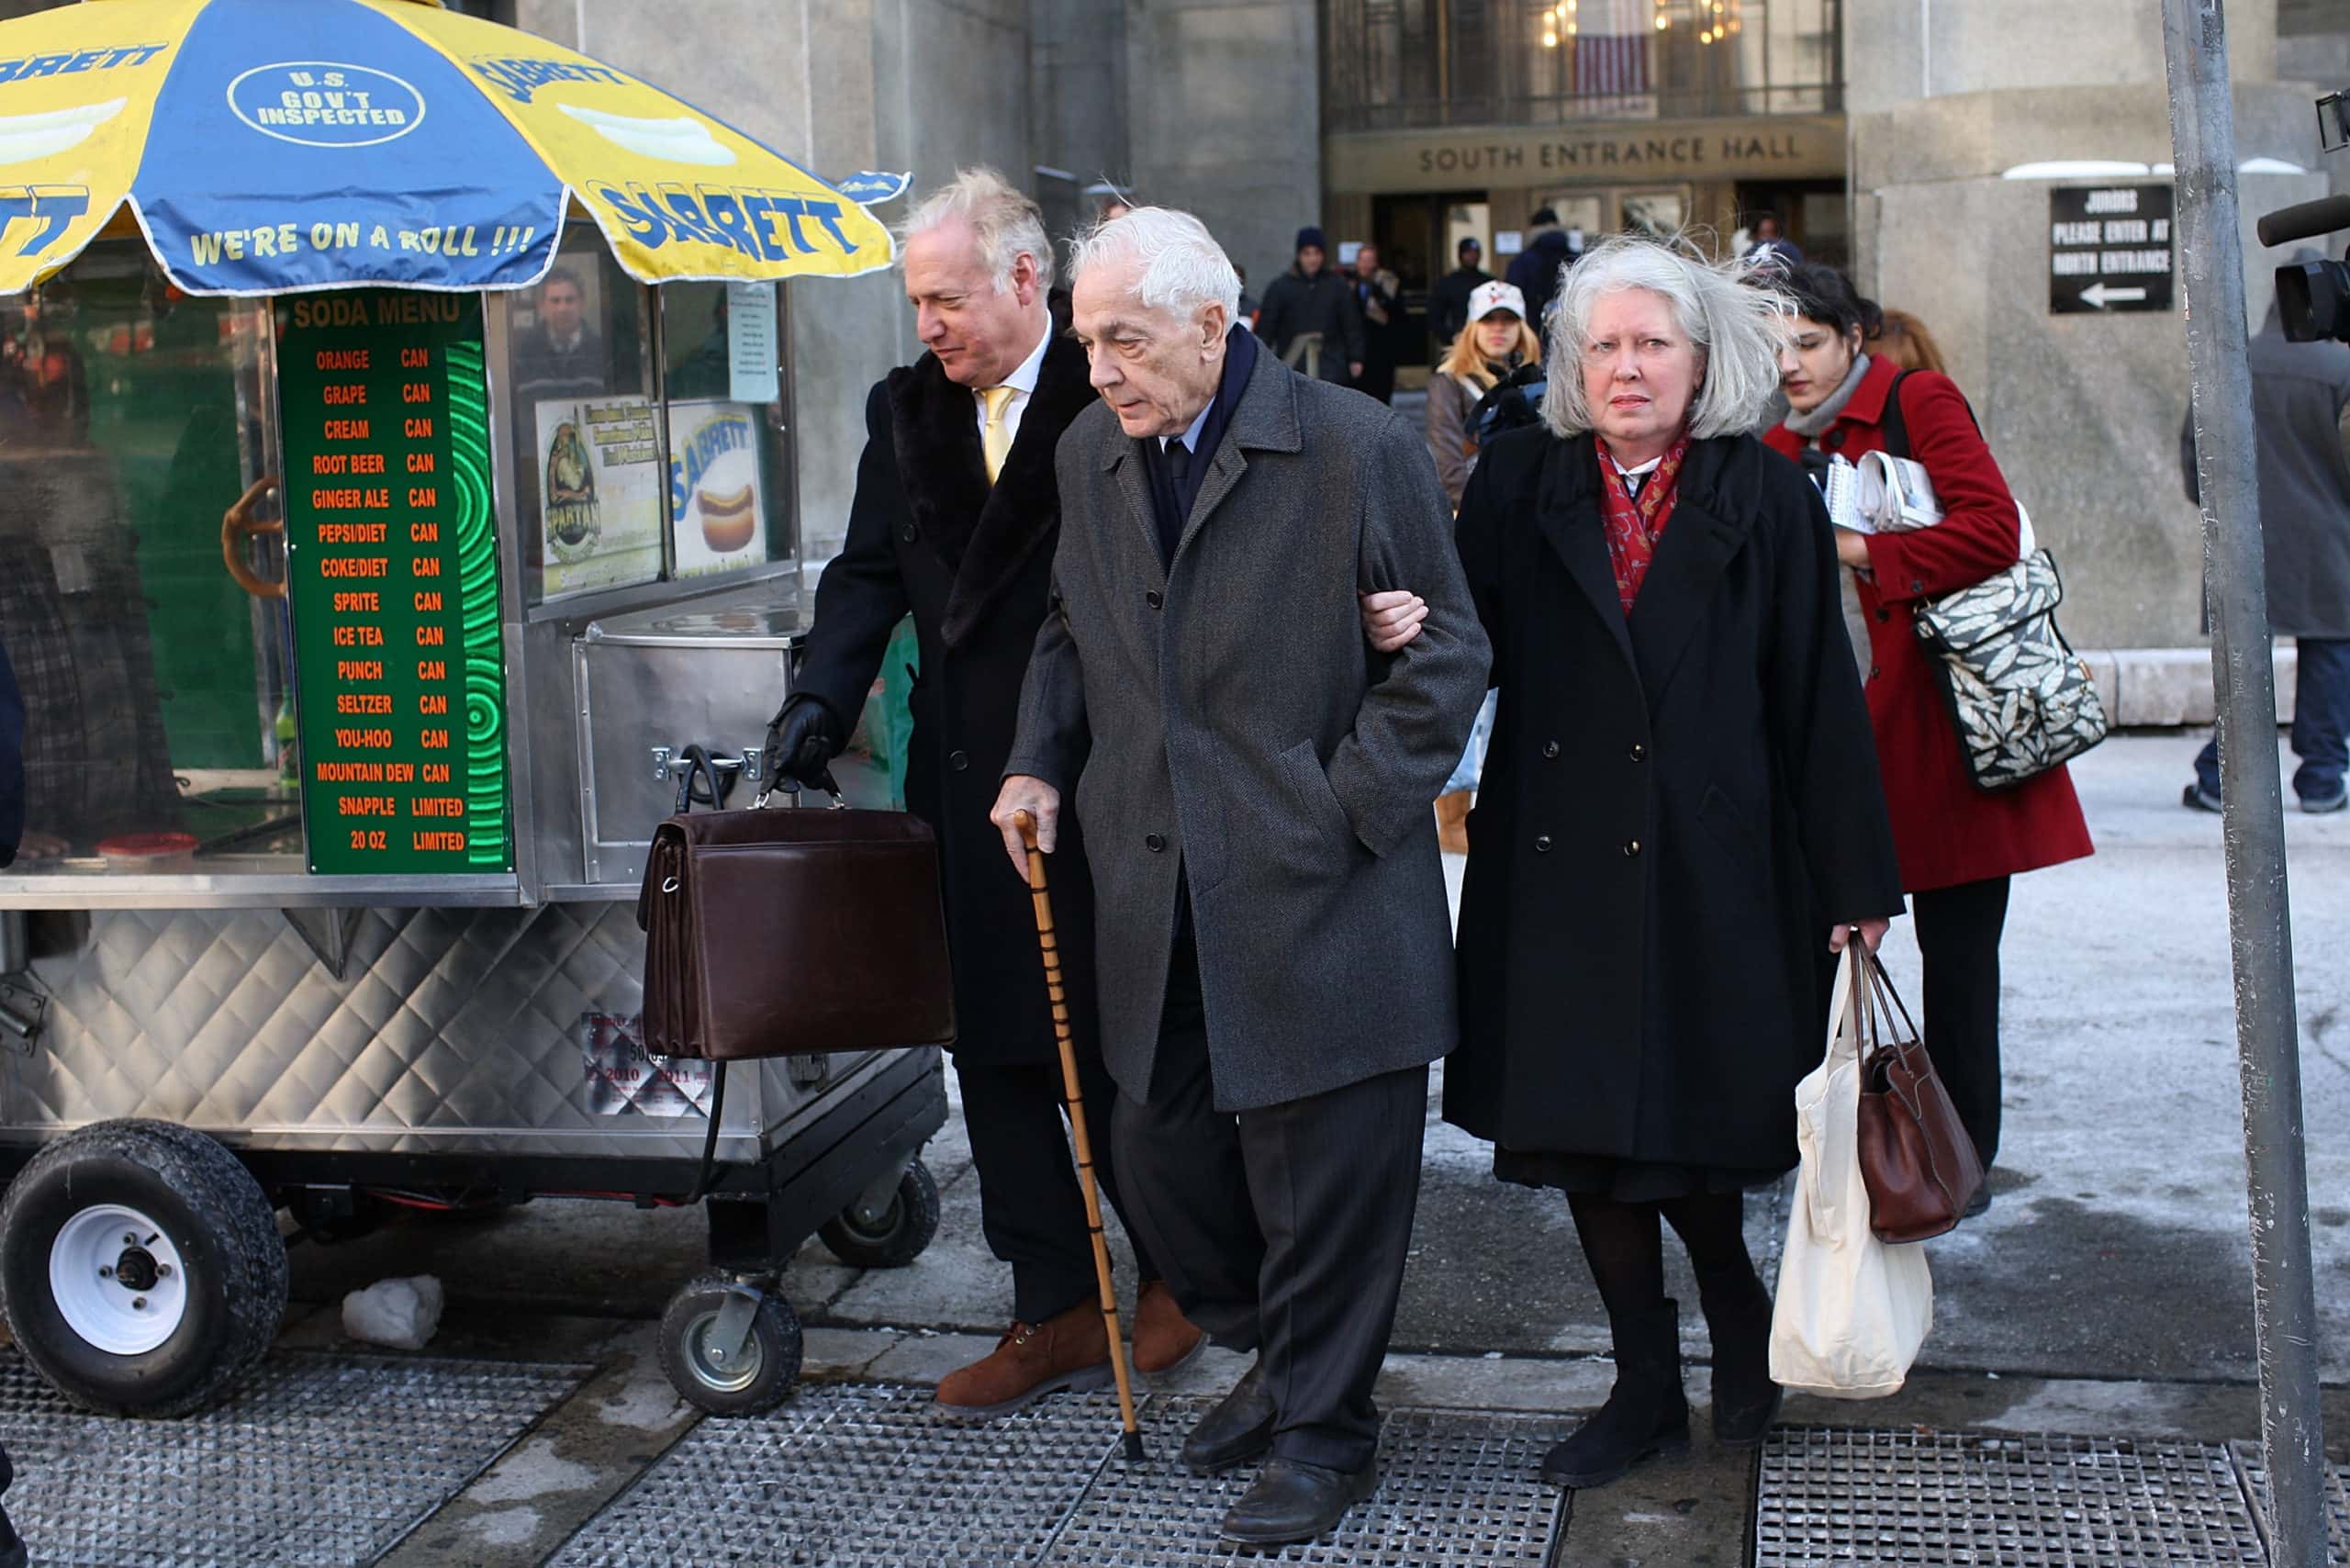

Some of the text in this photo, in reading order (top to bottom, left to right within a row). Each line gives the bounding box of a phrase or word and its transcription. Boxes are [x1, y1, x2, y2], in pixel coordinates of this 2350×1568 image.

[289, 71, 350, 88] U.S.
[280, 90, 370, 109] GOV'T
[256, 106, 407, 126] INSPECTED
[1419, 134, 1802, 174] SOUTH ENTRANCE HALL
[2053, 218, 2170, 246] PLEASE ENTER AT
[190, 223, 298, 267] WE'RE
[310, 221, 360, 251] ON
[370, 225, 390, 250] A
[398, 225, 479, 257] ROLL
[2100, 249, 2171, 274] ENTRANCE
[294, 293, 461, 328] SODA MENU
[317, 349, 429, 369] ORANGE CAN
[323, 384, 431, 405] GRAPE CAN
[324, 419, 433, 440] CREAM CAN
[312, 454, 434, 475] ROOT BEER CAN
[312, 488, 437, 509] GINGER ALE CAN
[318, 522, 439, 543] PEPSI/DIET CAN
[320, 557, 441, 577] COKE/DIET CAN
[333, 592, 442, 611] SPRITE CAN
[333, 626, 444, 646] ICE TEA CAN
[338, 661, 446, 680] PUNCH CAN
[337, 694, 448, 714] SELTZER CAN
[335, 729, 449, 748] YOU-HOO CAN
[317, 763, 450, 782] MOUNTAIN DEW CAN
[339, 797, 464, 817] SNAPPLE LIMITED
[352, 830, 464, 851] 20 OZ LIMITED
[605, 1068, 641, 1082] 2010
[655, 1069, 691, 1083] 2011
